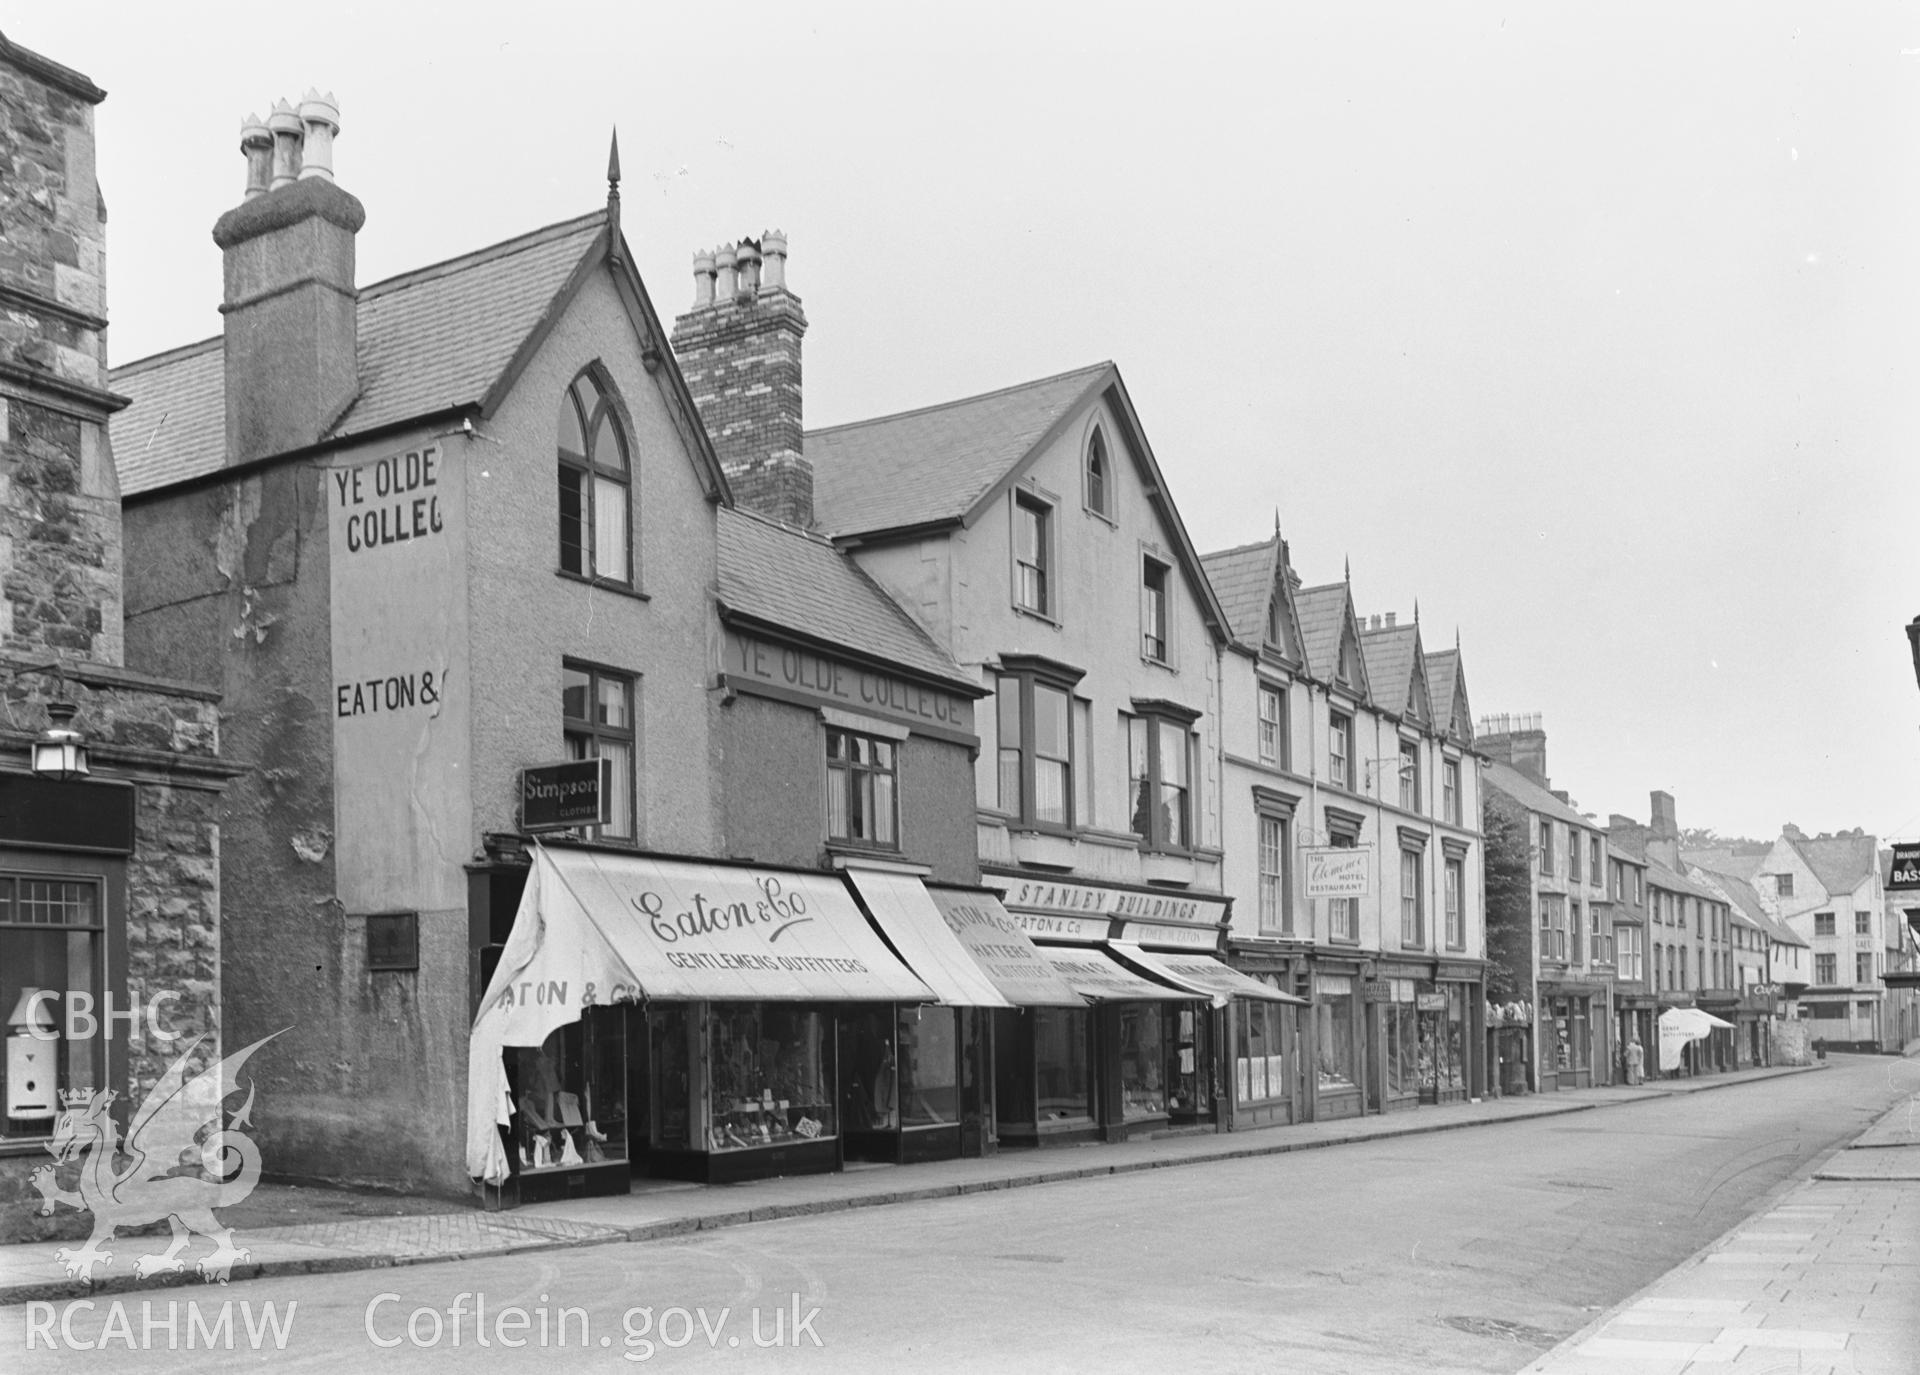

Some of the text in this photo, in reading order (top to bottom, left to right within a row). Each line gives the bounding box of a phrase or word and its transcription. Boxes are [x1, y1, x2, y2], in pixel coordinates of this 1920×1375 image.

[335, 448, 436, 506] YE OLDE
[337, 674, 415, 717] EATON
[737, 635, 962, 725] YE OLDE COLLEGE
[525, 774, 597, 803] Simpson
[1310, 855, 1325, 863] THE
[1310, 883, 1362, 892] RESTAURANT
[1893, 870, 1920, 882] BAS
[1019, 883, 1197, 919] STANLEY BUILDINGS
[631, 892, 755, 943] Eaton
[757, 900, 771, 923] &
[666, 951, 868, 973] GENTLEMENS OUTFITTERS
